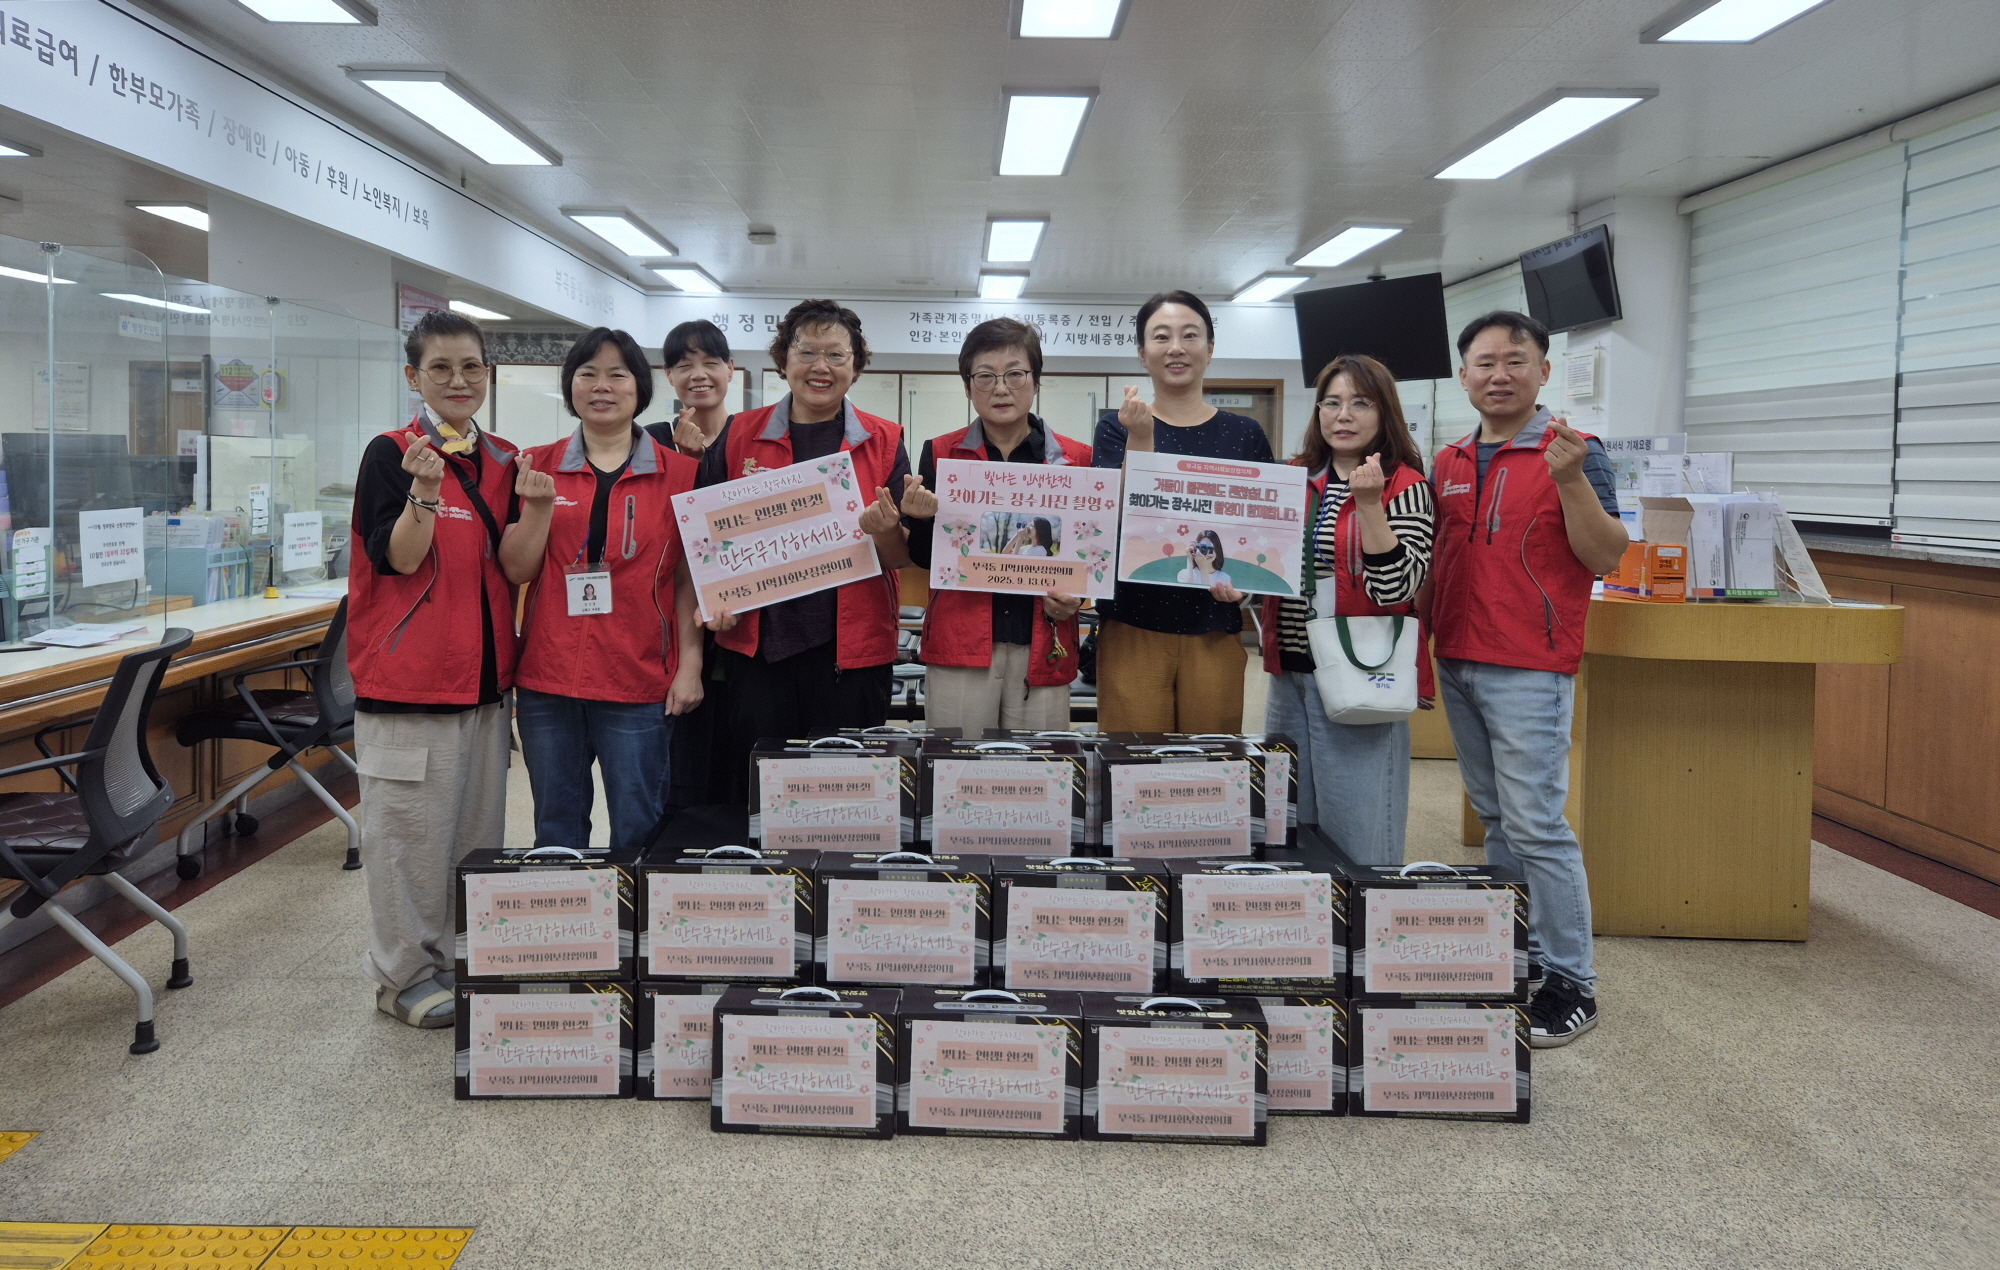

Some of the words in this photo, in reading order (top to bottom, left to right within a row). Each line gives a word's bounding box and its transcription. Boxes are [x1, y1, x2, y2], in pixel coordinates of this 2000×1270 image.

[108, 63, 201, 128] 한부모가족
[222, 116, 267, 159] 장애인
[285, 146, 310, 179] 아동
[327, 165, 348, 195] 후원
[362, 184, 401, 219] 노인복지
[412, 207, 430, 230] 보육
[909, 312, 993, 325] 가족관계증명서
[1088, 315, 1111, 327] 전입
[1065, 333, 1137, 346] 지방세증명서
[1627, 439, 1651, 451] 기재요령
[722, 484, 760, 502] 찾아가는
[764, 474, 803, 492] 장수사진
[985, 470, 1017, 487] 빛나는
[1153, 478, 1183, 493] 거동이
[1186, 481, 1226, 497] 불편해도
[948, 488, 1004, 505] 찾아가는
[1011, 493, 1068, 509] 장수사진
[1073, 495, 1101, 511] 촬영
[1129, 493, 1169, 509] 찾아가는
[1172, 497, 1211, 513] 장수사진
[1214, 501, 1244, 517] 촬영이
[713, 514, 751, 532] 빛나는
[719, 522, 847, 571] 만수무강하세요
[972, 562, 997, 571] 부곡동
[1000, 563, 1073, 575] 지역사회보장협의체
[719, 584, 752, 602] 부곡동
[756, 557, 853, 592] 지역사회보장협의체
[988, 575, 1015, 584] 2025.
[1018, 577, 1024, 585] 9.
[786, 805, 882, 825] 만수무강하세요
[958, 808, 1054, 827] 만수무강하세요
[1137, 809, 1232, 831] 만수무강하세요
[495, 921, 599, 944] 만수무강하세요
[675, 925, 775, 945] 만수무강하세요
[854, 932, 956, 954] 만수무강하세요
[1210, 926, 1313, 947] 만수무강하세요
[1032, 940, 1134, 962] 만수무강하세요
[1393, 941, 1495, 961] 만수무강하세요
[497, 1044, 600, 1065] 만수무강하세요
[1391, 1061, 1496, 1080] 만수무강하세요
[750, 1071, 856, 1094] 만수무강하세요
[938, 1075, 1045, 1099] 만수무강하세요
[1127, 1082, 1234, 1104] 만수무강하세요
